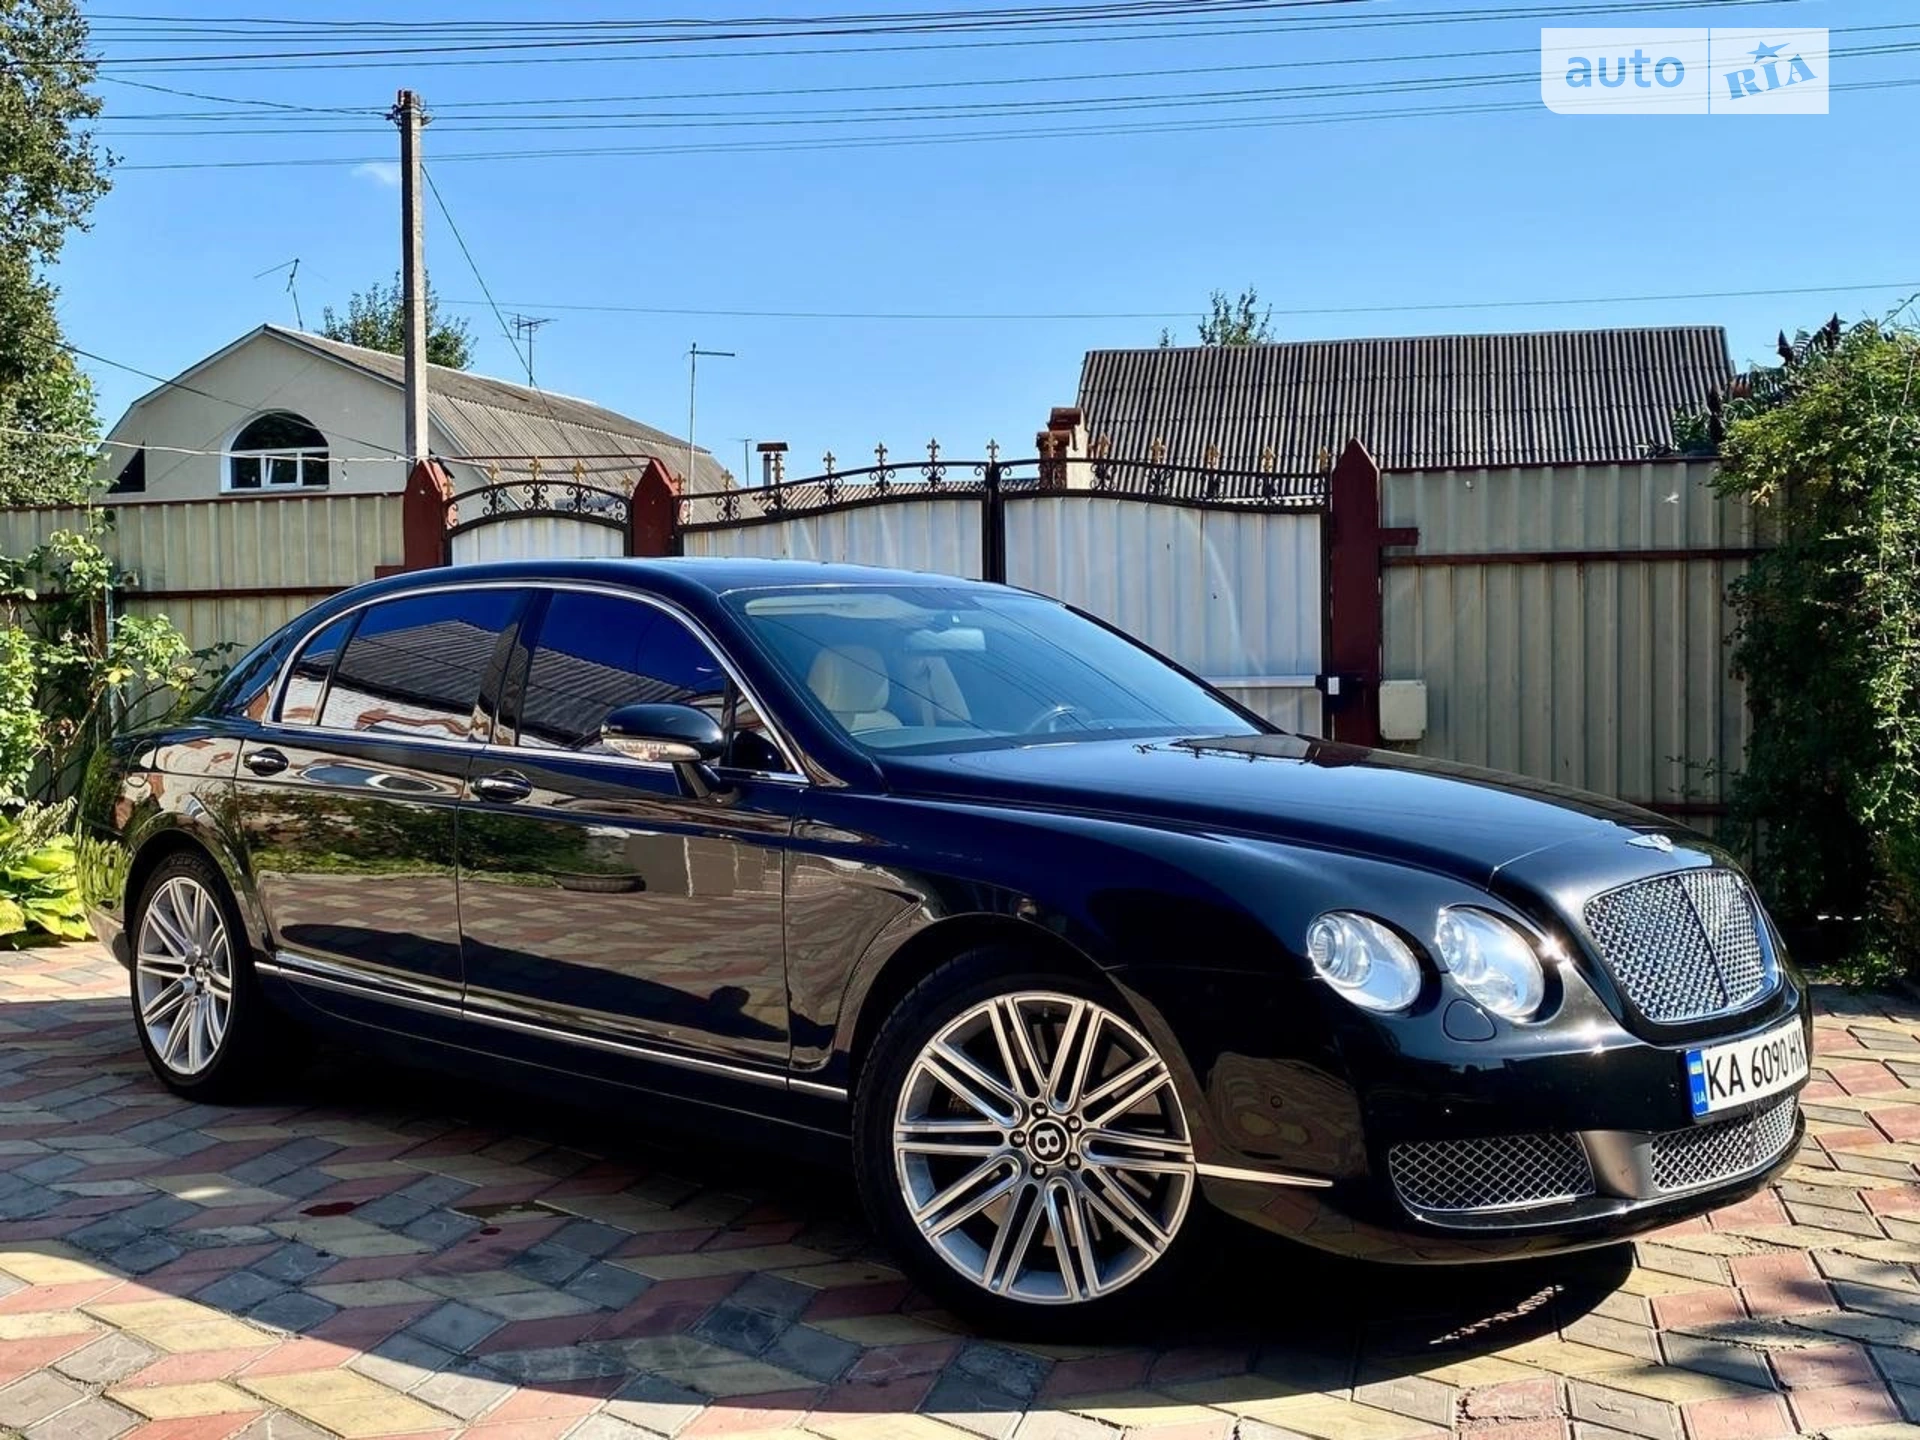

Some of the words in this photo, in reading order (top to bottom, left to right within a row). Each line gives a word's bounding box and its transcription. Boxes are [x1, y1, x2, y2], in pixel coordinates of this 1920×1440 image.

[1706, 1053, 1746, 1100] KA
[1751, 1039, 1788, 1088] 6090
[1694, 1091, 1706, 1105] UA
